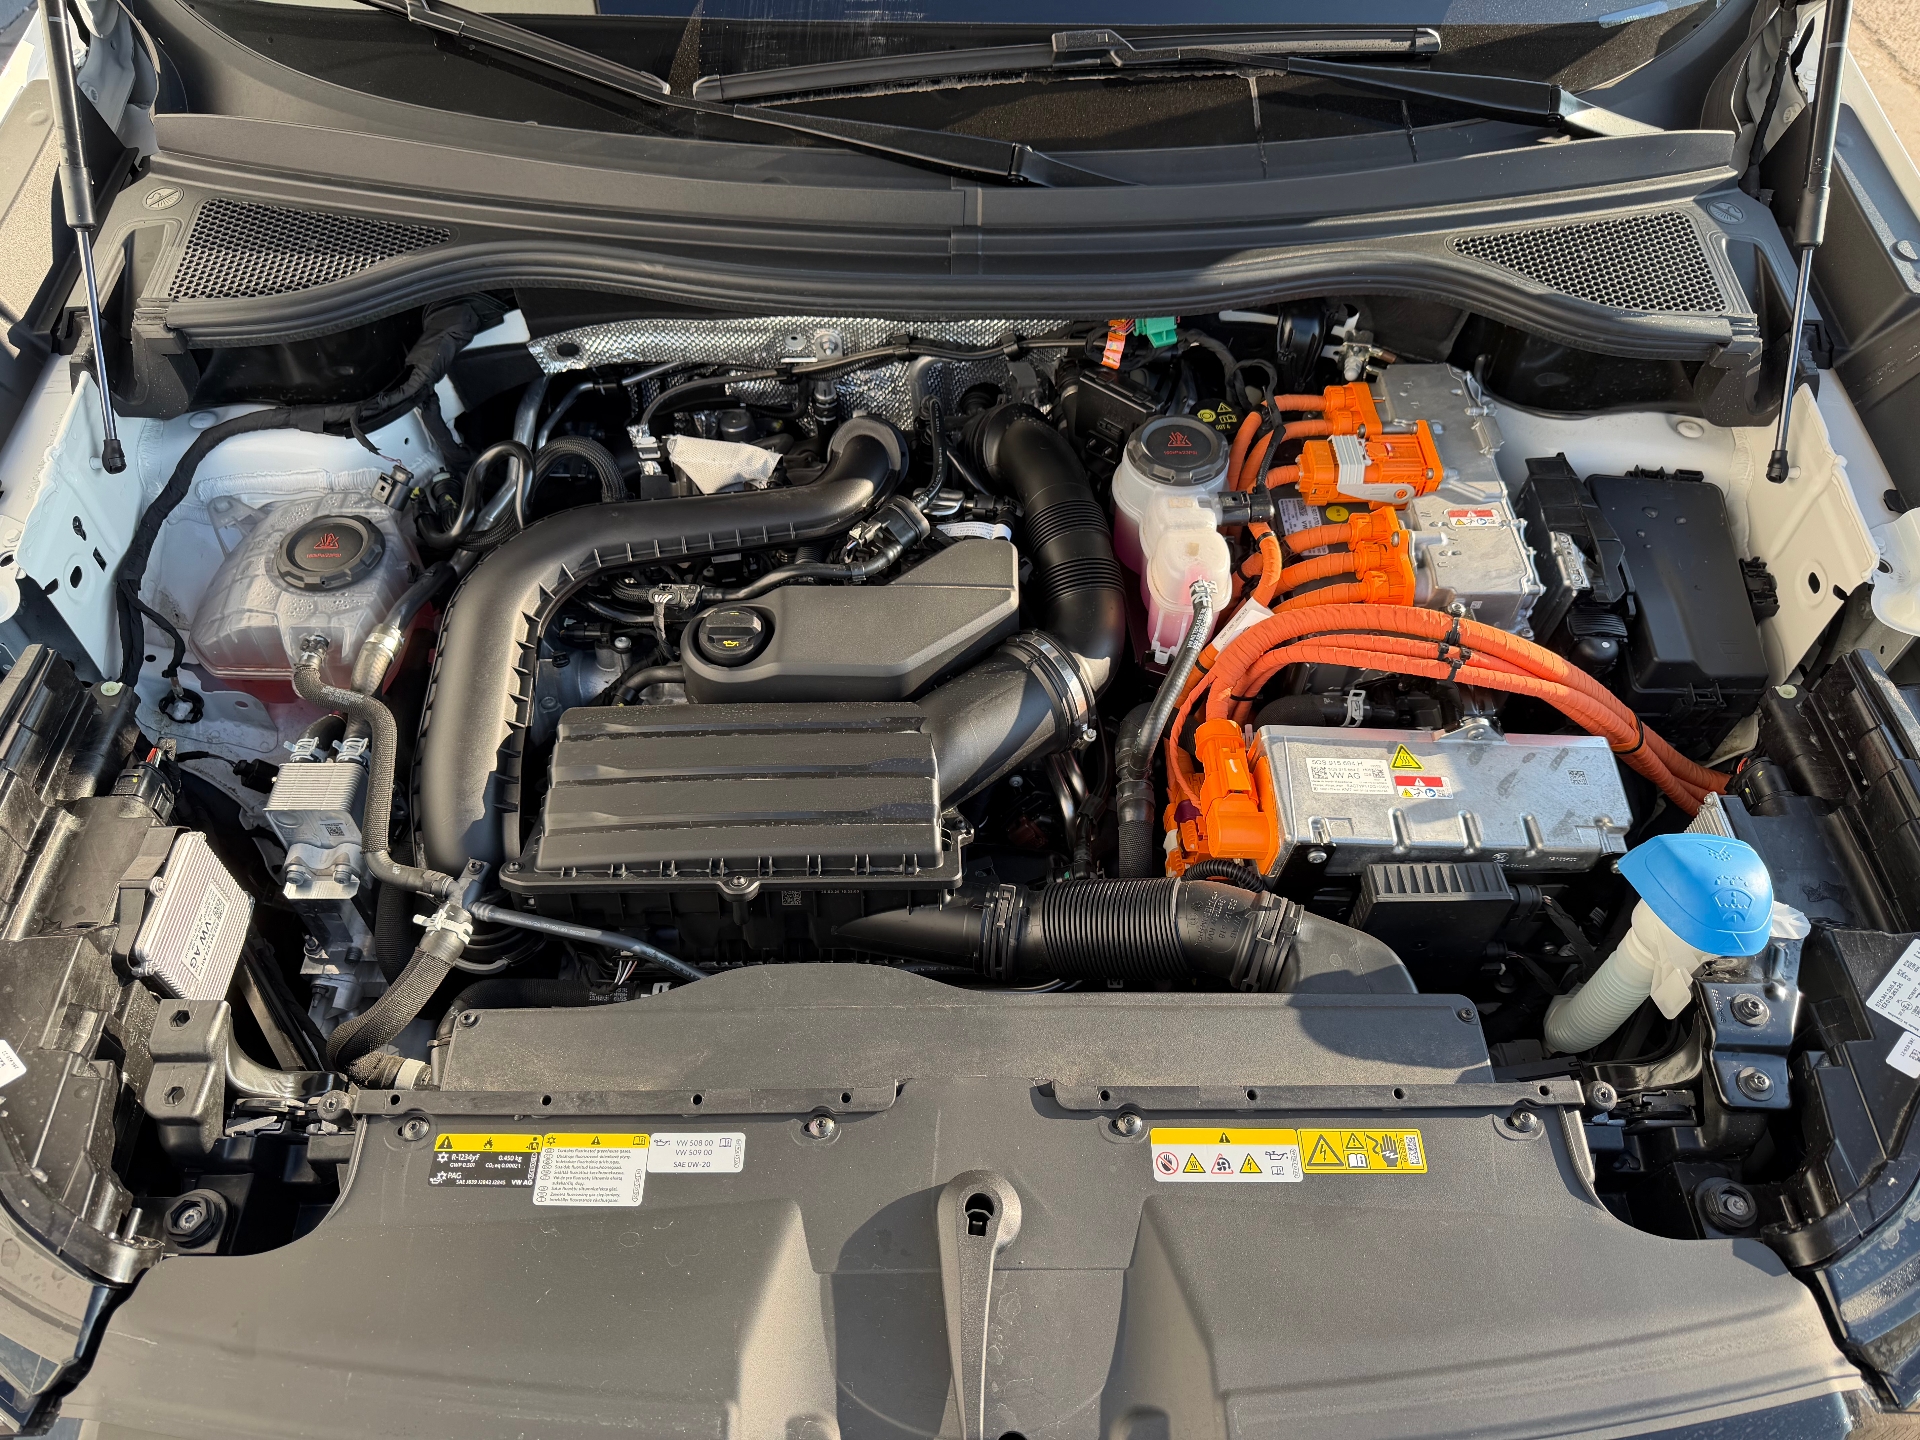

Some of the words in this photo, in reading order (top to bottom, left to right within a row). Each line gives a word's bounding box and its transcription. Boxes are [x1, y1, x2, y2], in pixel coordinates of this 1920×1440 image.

[200, 922, 211, 945] VW
[190, 945, 200, 968] AG
[451, 1154, 480, 1162] R-1234yf
